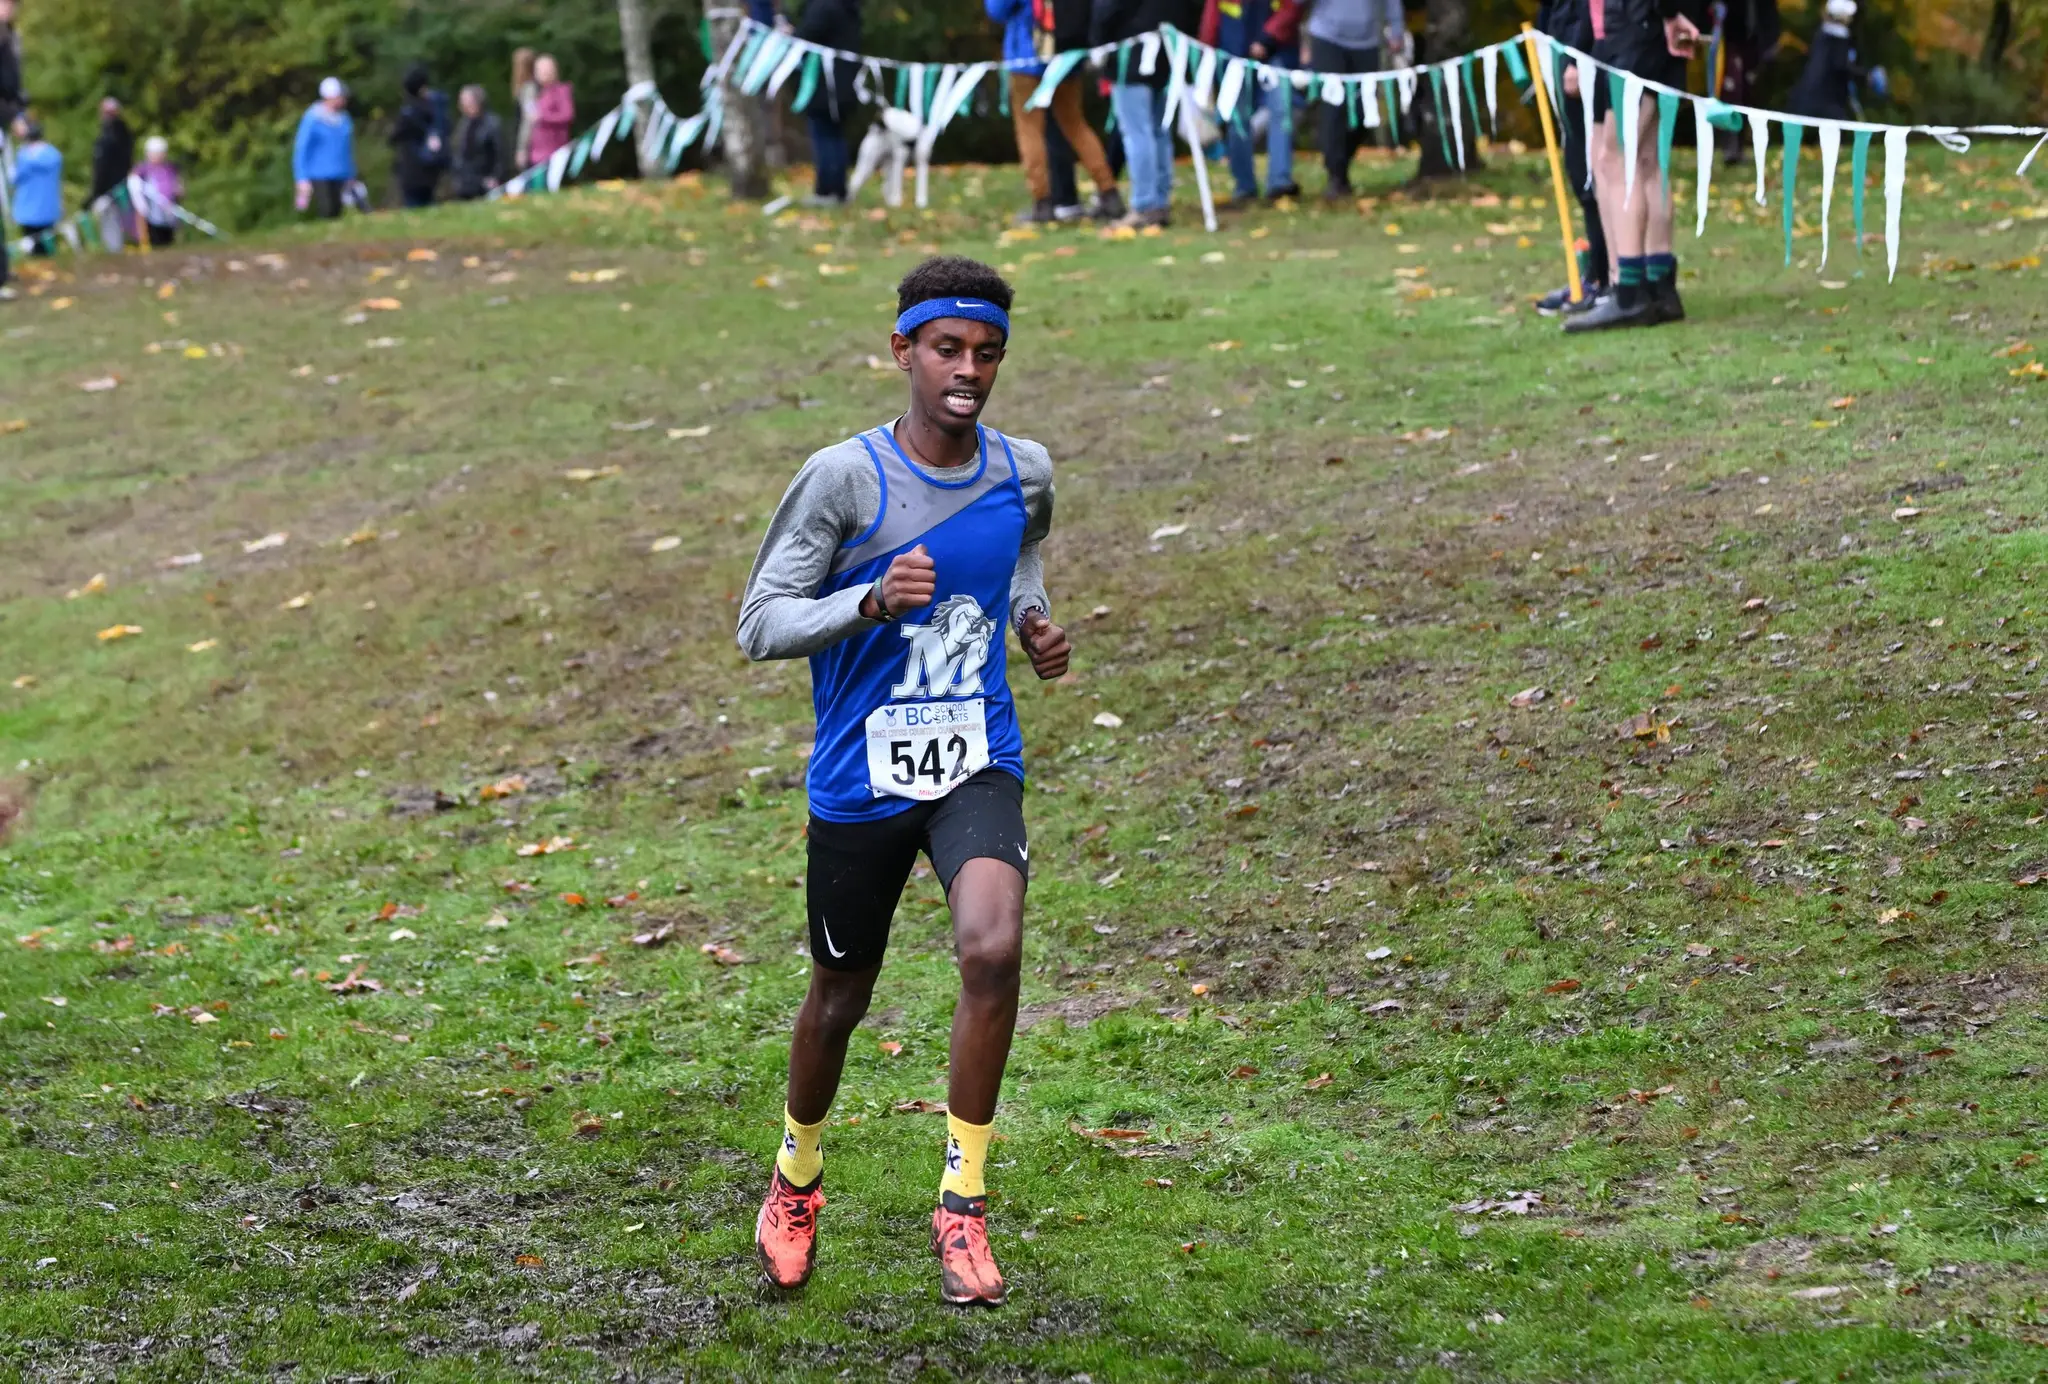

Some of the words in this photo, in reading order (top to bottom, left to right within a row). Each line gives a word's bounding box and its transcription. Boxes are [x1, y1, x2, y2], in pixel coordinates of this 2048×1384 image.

[891, 617, 997, 699] M
[906, 706, 933, 726] BC
[935, 703, 968, 714] SCHOOL
[935, 712, 969, 724] SPORTS
[890, 733, 968, 786] 542
